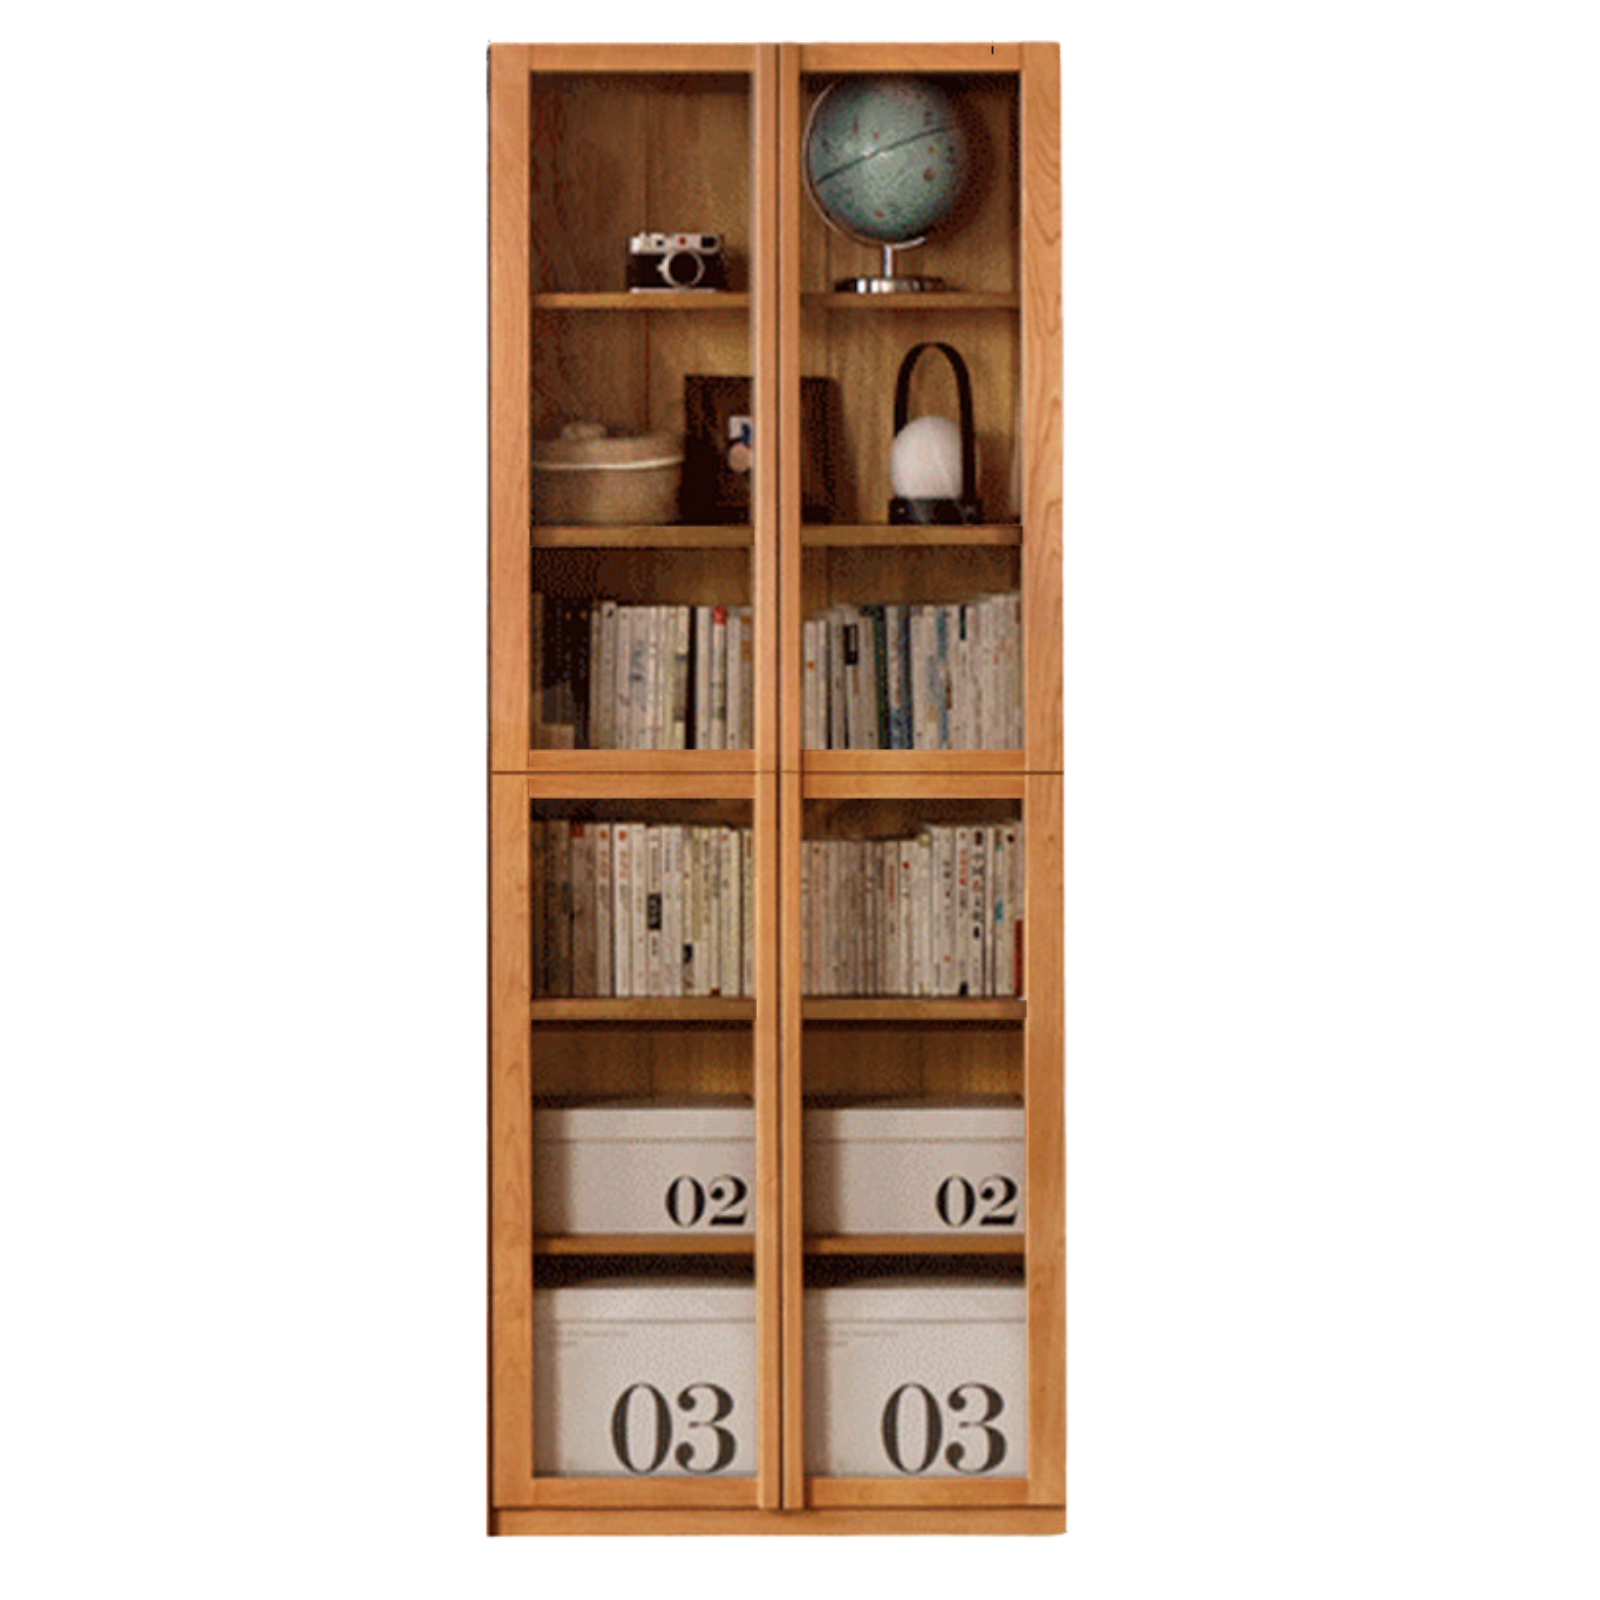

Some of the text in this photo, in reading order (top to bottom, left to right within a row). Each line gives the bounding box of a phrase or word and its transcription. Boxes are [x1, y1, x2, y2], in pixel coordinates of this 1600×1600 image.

[665, 1174, 747, 1227] 02
[935, 1174, 1018, 1227] 02
[610, 1382, 738, 1475] 03
[880, 1382, 1008, 1475] 03
